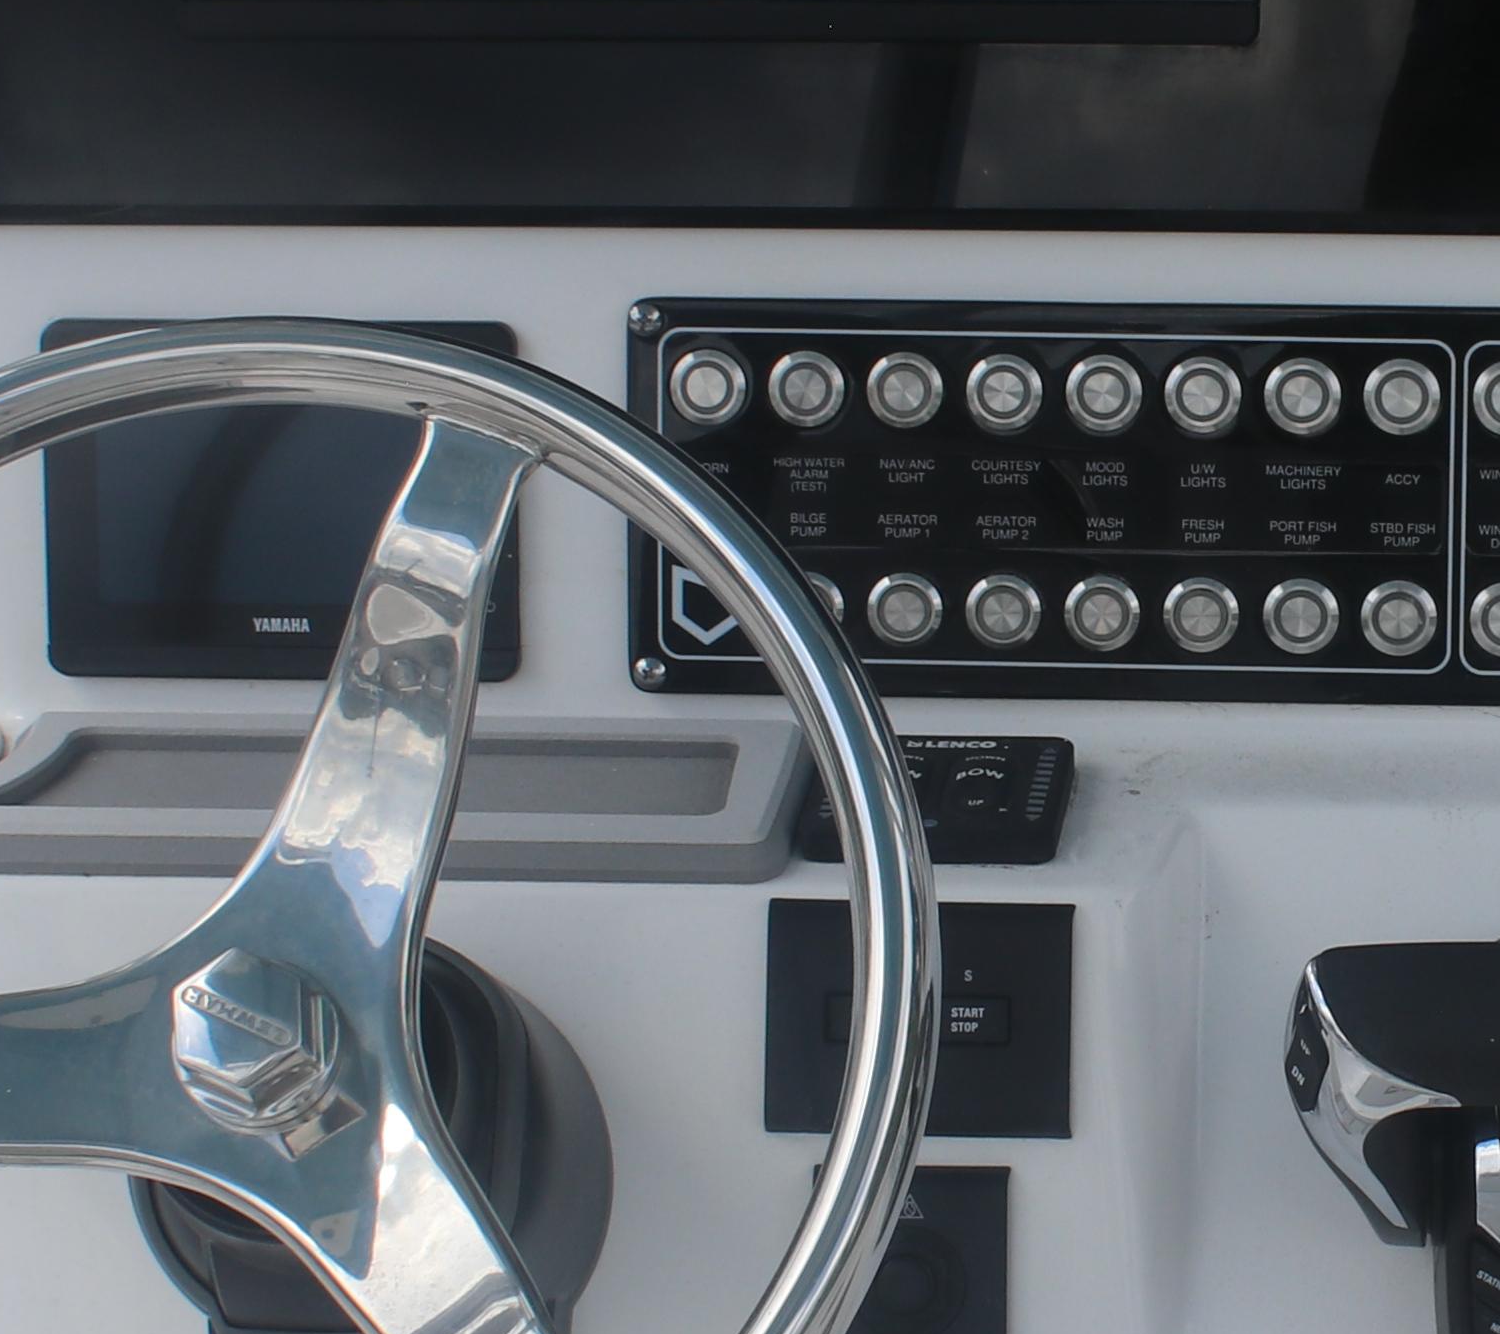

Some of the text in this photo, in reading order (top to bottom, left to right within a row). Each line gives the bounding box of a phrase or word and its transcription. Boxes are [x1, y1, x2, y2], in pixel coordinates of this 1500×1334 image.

[773, 457, 844, 467] HIGH WATER
[971, 459, 1040, 471] COURTESY
[1085, 461, 1124, 473] MOOD
[790, 470, 828, 479] ALARM
[1265, 464, 1341, 476] MACHINERY
[888, 472, 925, 482] LIGHT
[983, 473, 1028, 484] LIGHTS
[1082, 474, 1127, 486] LIGHTS
[1180, 476, 1226, 488] LIGHTS
[1385, 473, 1420, 485] ACCY
[790, 481, 826, 492] (TEST)
[1280, 478, 1325, 490] LIGHTS
[790, 512, 826, 523] BILGE
[877, 514, 937, 525] AERATOR
[975, 515, 1036, 527] AERATOR
[1086, 517, 1124, 528] WASH
[1181, 518, 1224, 530] FRESH
[1269, 520, 1336, 532] PORT FISH
[1370, 522, 1435, 534] STBD FISH
[790, 525, 826, 536] PUMP
[884, 527, 929, 538] PUMP 1
[982, 528, 1028, 540] PUMP 2
[1086, 530, 1122, 541] PUMP
[1184, 532, 1220, 543] PUMP
[1284, 534, 1320, 545] PUMP
[1384, 535, 1420, 547] PUMP
[253, 617, 309, 632] YAMAHA
[925, 740, 997, 749] LENCO
[955, 767, 1004, 781] BOW
[964, 969, 972, 981] S
[181, 983, 293, 1046] LEWMAR
[951, 1007, 984, 1017] START
[950, 1021, 978, 1032] STOP
[1291, 1065, 1305, 1086] DN
